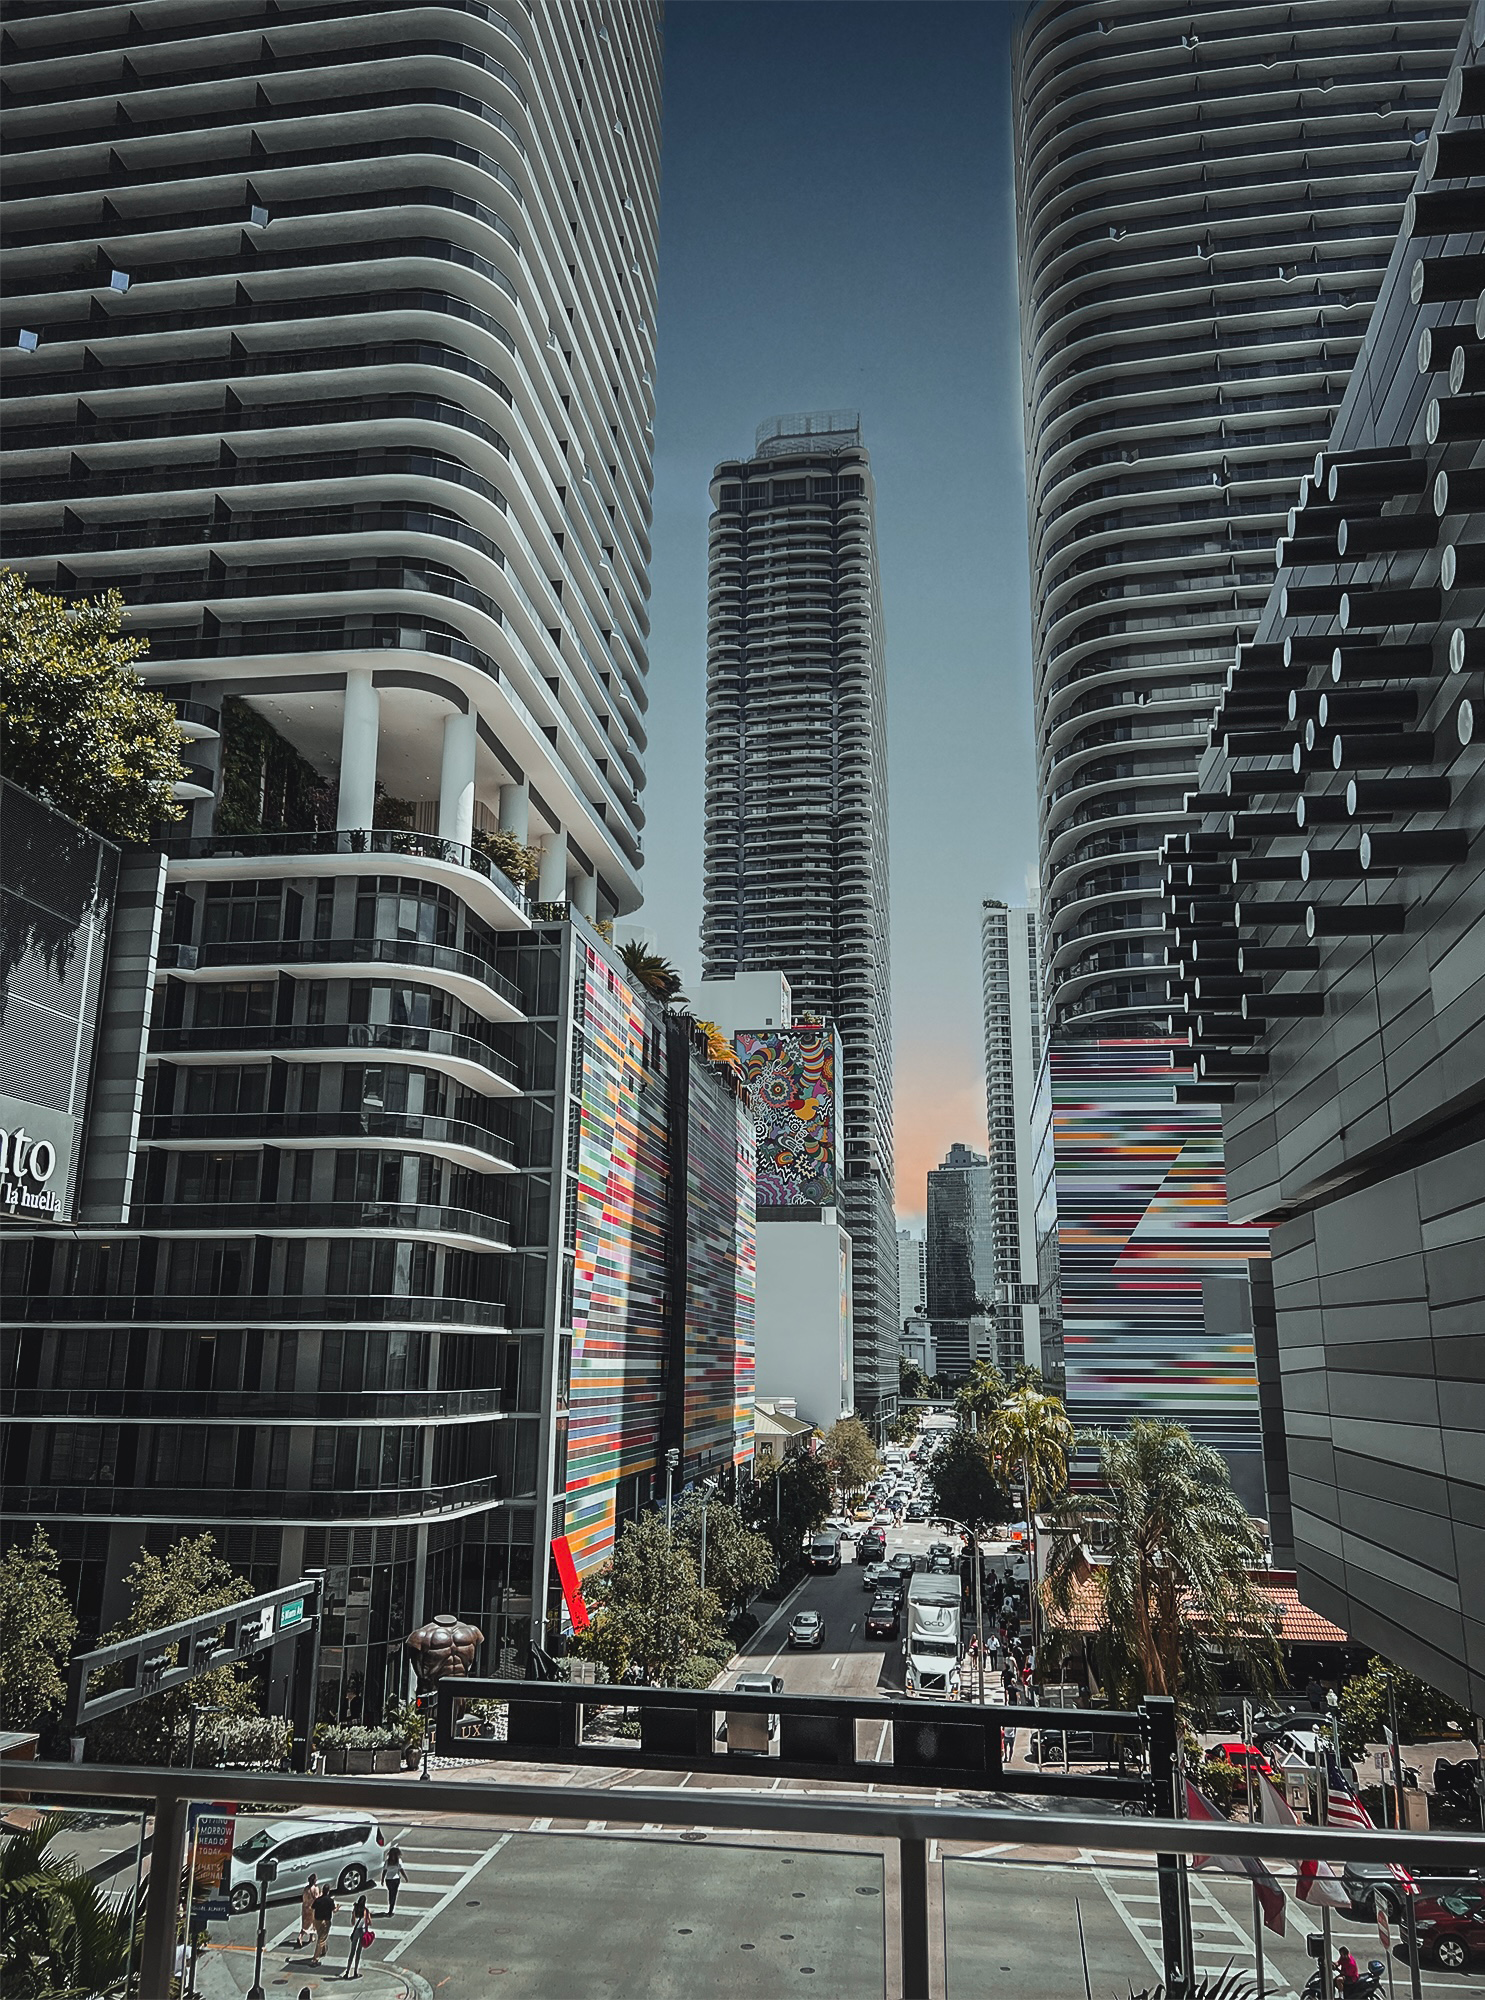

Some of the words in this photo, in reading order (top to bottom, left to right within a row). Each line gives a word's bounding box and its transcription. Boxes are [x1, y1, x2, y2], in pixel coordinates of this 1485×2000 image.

[21, 1185, 61, 1212] huella
[461, 1724, 482, 1739] UX
[198, 1837, 218, 1845] HEAD
[219, 1838, 229, 1846] OF
